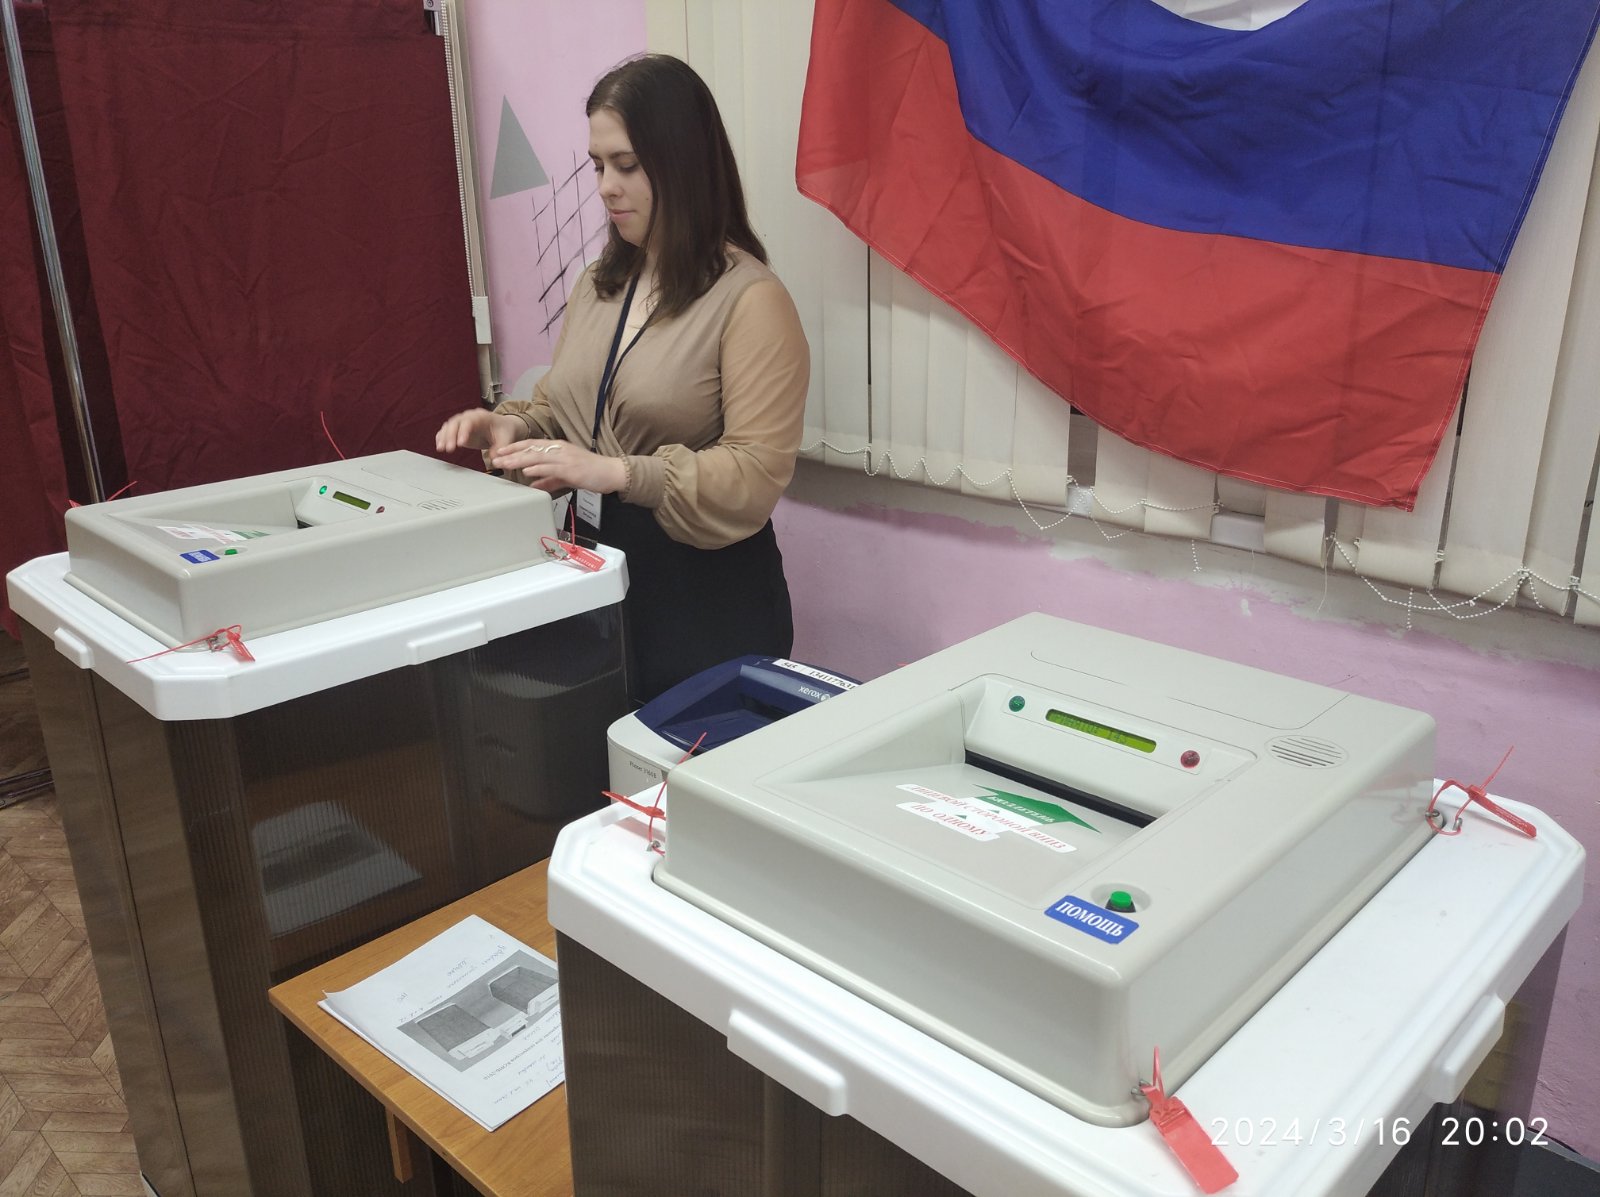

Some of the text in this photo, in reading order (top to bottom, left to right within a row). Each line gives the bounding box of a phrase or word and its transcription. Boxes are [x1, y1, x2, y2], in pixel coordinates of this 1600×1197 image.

[798, 685, 822, 699] xerox
[911, 803, 988, 836] ПО ОДНОМУ
[1028, 828, 1067, 849] ВНИЗ
[1055, 901, 1125, 937] ПОМОЩЬ
